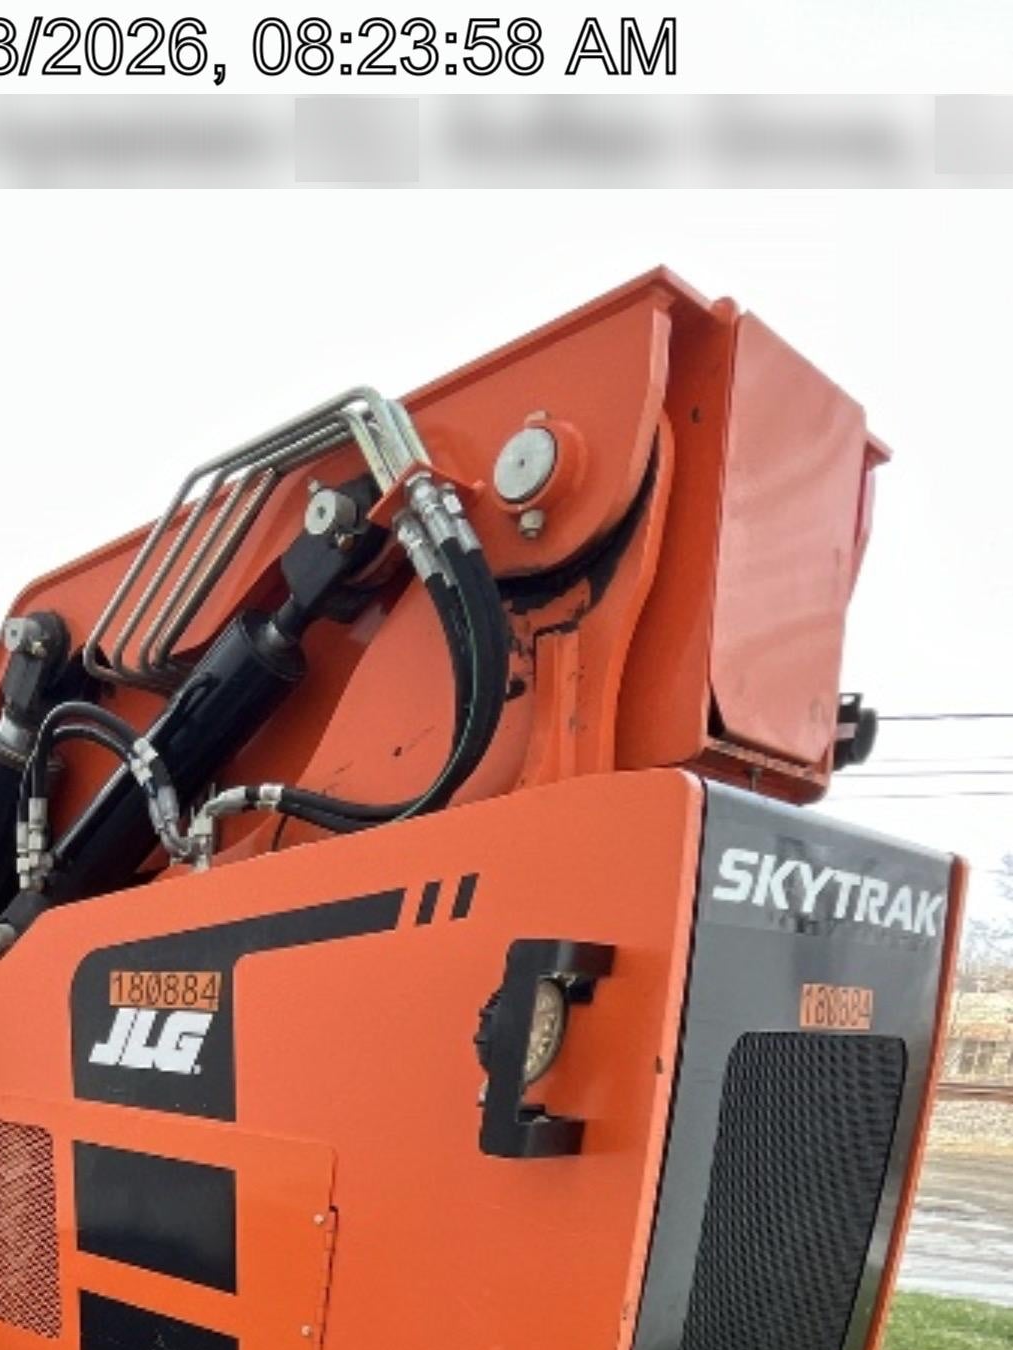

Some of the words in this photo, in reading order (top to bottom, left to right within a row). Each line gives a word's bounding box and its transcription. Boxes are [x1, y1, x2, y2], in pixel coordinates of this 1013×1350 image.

[713, 848, 943, 937] SKYTRAK
[111, 972, 219, 1009] 180884
[88, 1007, 213, 1075] JLG
